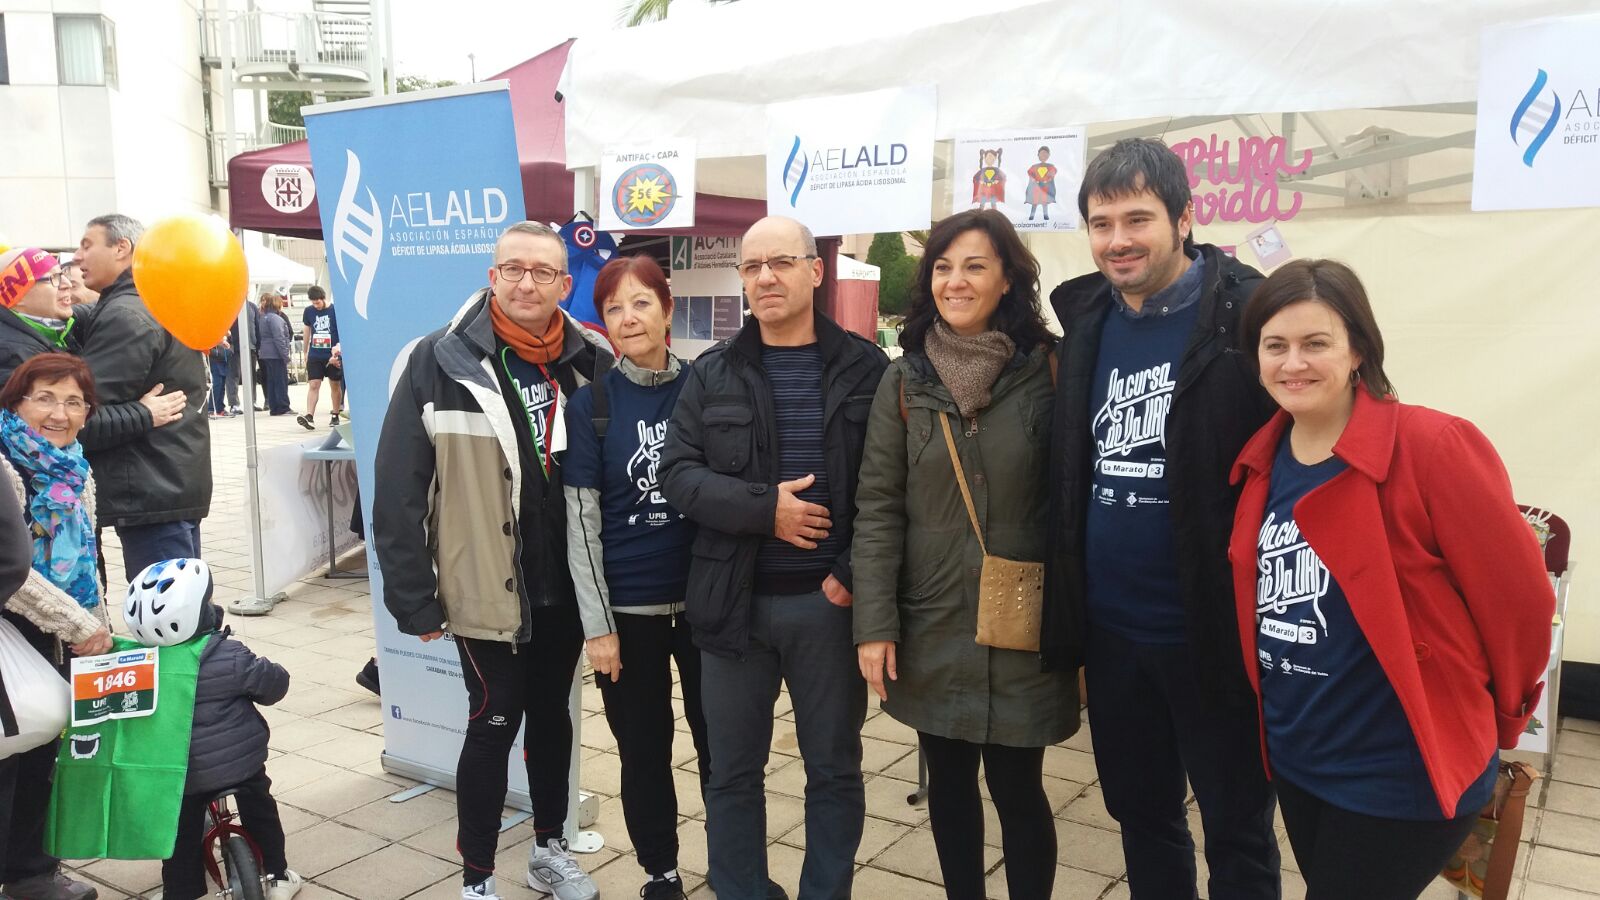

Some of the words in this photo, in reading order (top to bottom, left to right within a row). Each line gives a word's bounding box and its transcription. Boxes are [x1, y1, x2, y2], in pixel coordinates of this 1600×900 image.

[1565, 87, 1600, 119] A
[1565, 121, 1600, 132] ASOC
[1563, 134, 1598, 145] DÉFICIT
[616, 152, 650, 163] ANTIFAÇ
[657, 150, 679, 160] CAPA
[810, 143, 908, 173] AELALD
[829, 182, 836, 190] DE
[836, 180, 855, 189] LIPASA
[873, 177, 907, 186] LISOSOMAL
[637, 188, 652, 200] 5€
[389, 187, 508, 228] AELALD
[389, 229, 450, 243] ASOCIACIÓN
[392, 244, 415, 256] DÉFICIT
[417, 245, 425, 255] DE
[426, 244, 449, 255] LIPASA
[451, 242, 470, 254] ÁCIDA
[471, 243, 496, 254] LISOSO
[93, 670, 137, 693] 1846
